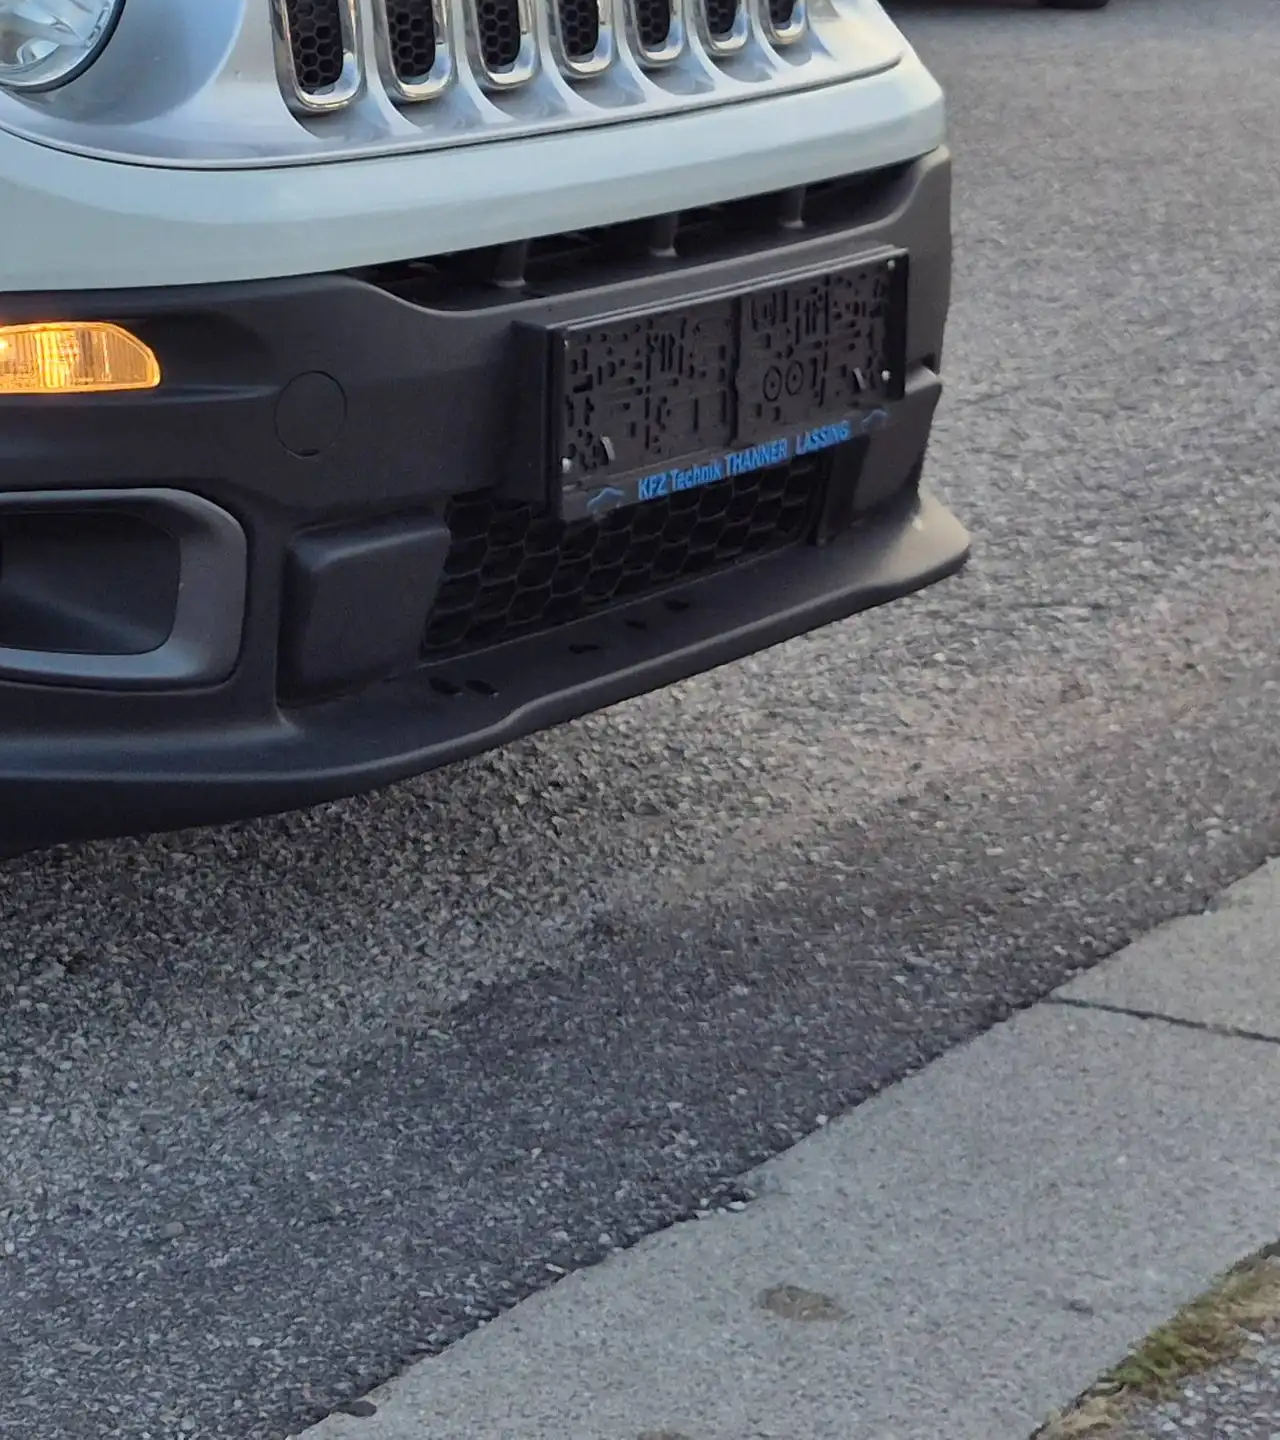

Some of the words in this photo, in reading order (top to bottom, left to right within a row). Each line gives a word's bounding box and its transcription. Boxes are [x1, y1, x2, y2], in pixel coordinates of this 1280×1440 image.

[637, 472, 669, 501] KFZ
[670, 459, 723, 492] Technik
[724, 438, 790, 477] THANNER
